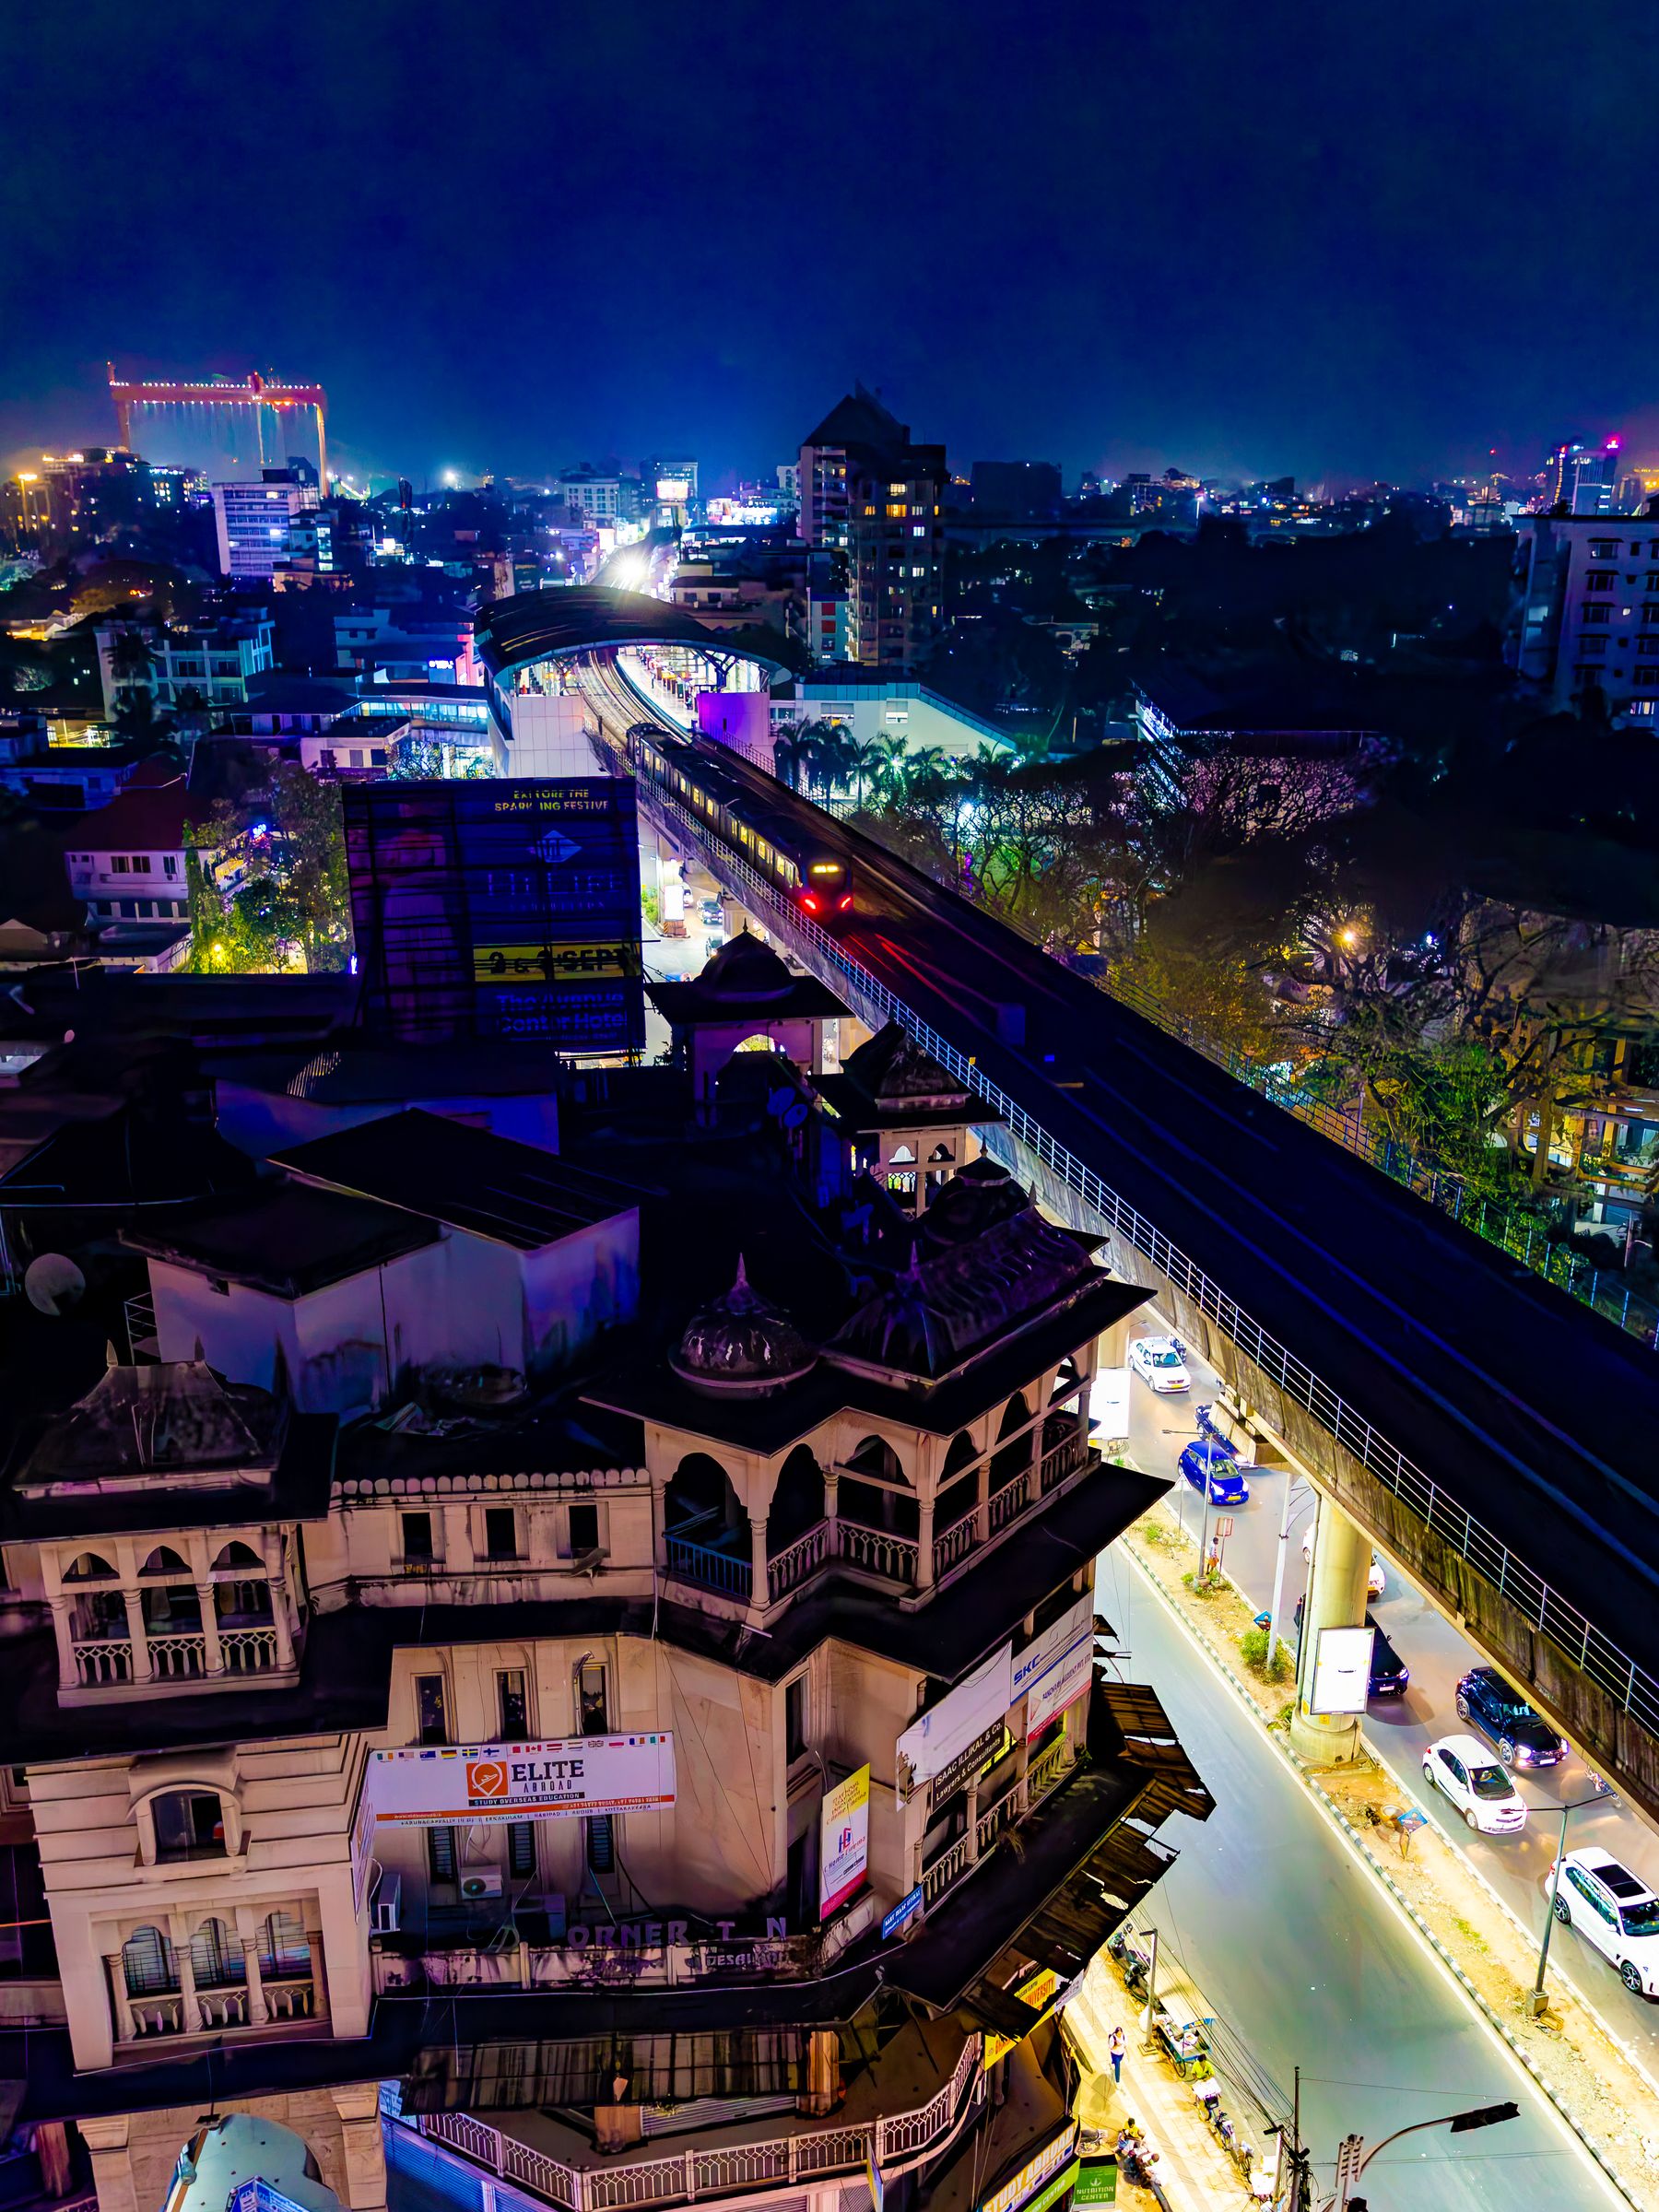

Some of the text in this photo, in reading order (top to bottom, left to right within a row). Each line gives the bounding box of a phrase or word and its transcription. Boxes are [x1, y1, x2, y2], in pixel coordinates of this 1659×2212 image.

[1014, 1653, 1041, 1686] SKC
[935, 1761, 958, 1788] ISAAC
[984, 1731, 990, 1741] &
[991, 1722, 1002, 1735] Co.
[935, 1736, 1001, 1801] Lawyers & Consultants
[512, 1759, 584, 1783] ELITE
[474, 1798, 498, 1806] STUDY
[500, 1796, 537, 1806] OVERSEAS
[538, 1793, 580, 1803] EDUCATION
[524, 1780, 572, 1794] ABROAD
[982, 2126, 1074, 2212] STUDY ABROAD
[1077, 2185, 1114, 2195] NUTRITION
